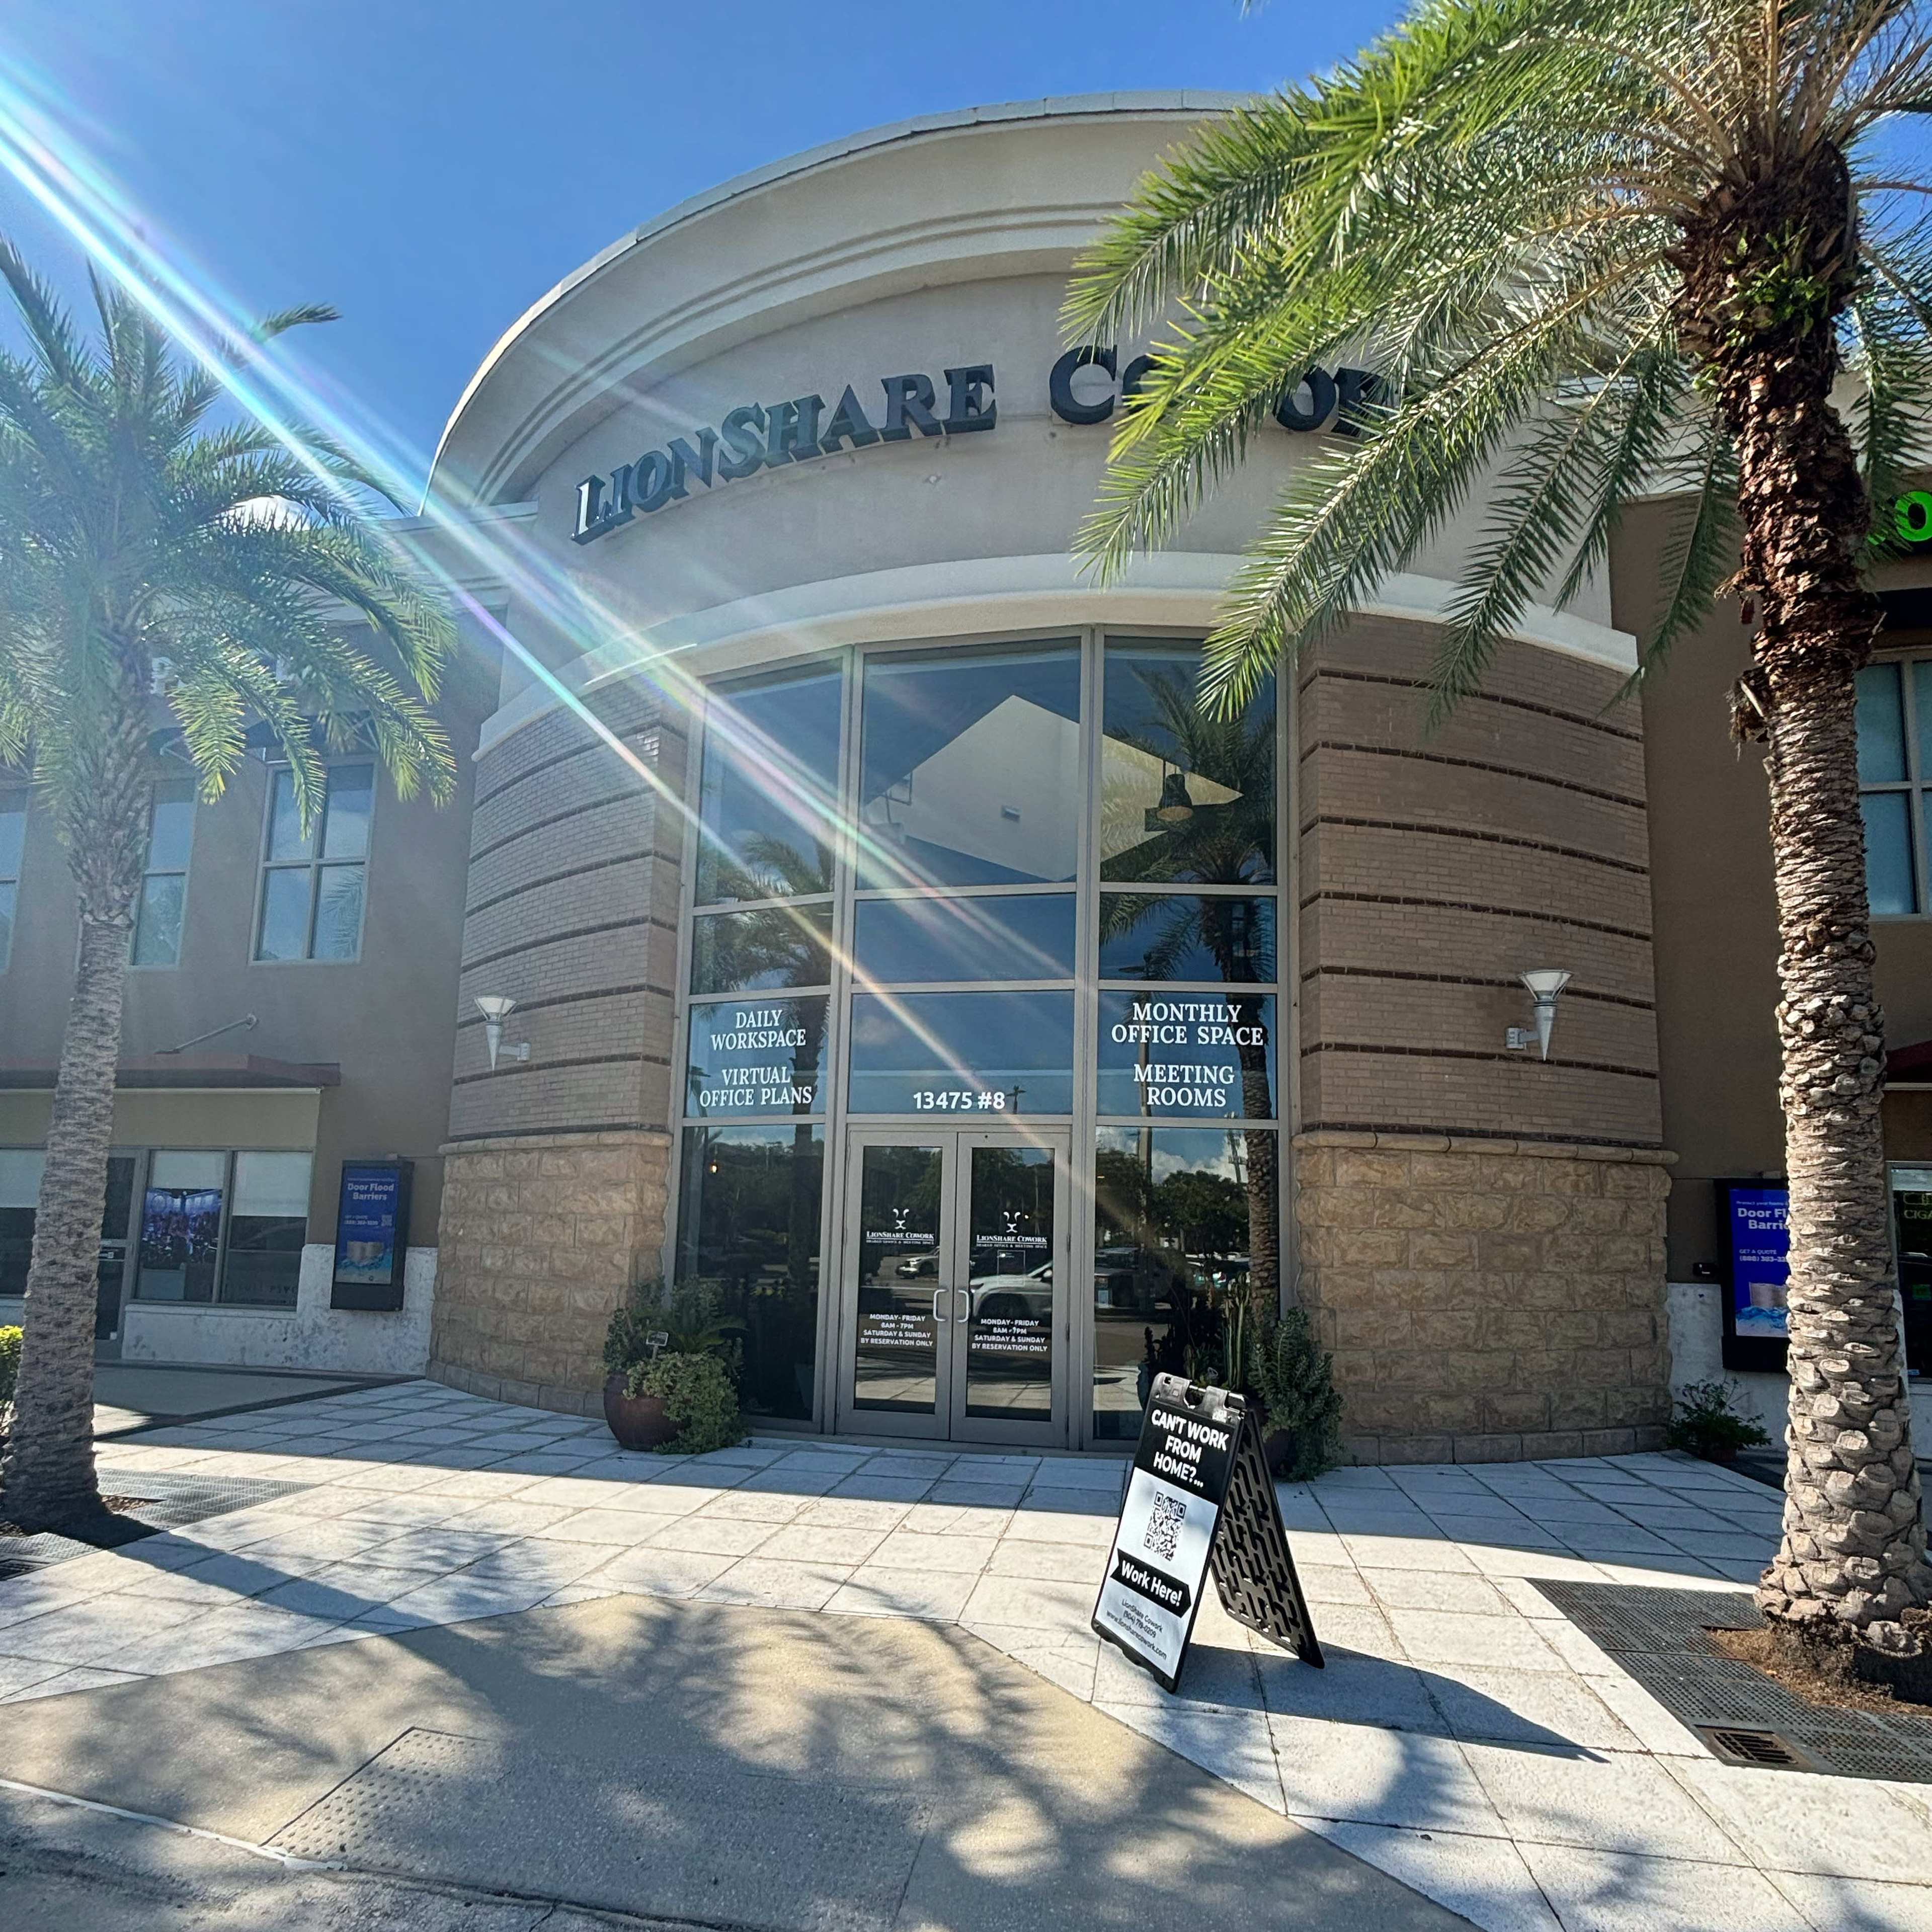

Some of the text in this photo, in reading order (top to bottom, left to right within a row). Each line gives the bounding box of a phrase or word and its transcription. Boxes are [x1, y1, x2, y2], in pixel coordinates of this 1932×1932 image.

[571, 364, 997, 545] LIONSHARE
[736, 1009, 782, 1029] DAILY
[1132, 1003, 1242, 1022] MONTHLY
[711, 1029, 806, 1051] WORKSPACE
[1111, 1024, 1263, 1045] OFFICE SPACE
[721, 1066, 791, 1086] VIRTUAL
[1134, 1064, 1235, 1084] MEETING
[700, 1086, 812, 1107] OFFICE PLANS
[913, 1092, 1005, 1109] 13475 #8
[1147, 1087, 1226, 1107] ROOMS
[353, 1192, 387, 1200] Barriers
[1738, 1208, 1772, 1217] Door
[1151, 1409, 1229, 1451] CAN'T WORK
[1165, 1435, 1202, 1463] FROM
[1121, 1560, 1183, 1606] Work Here!
